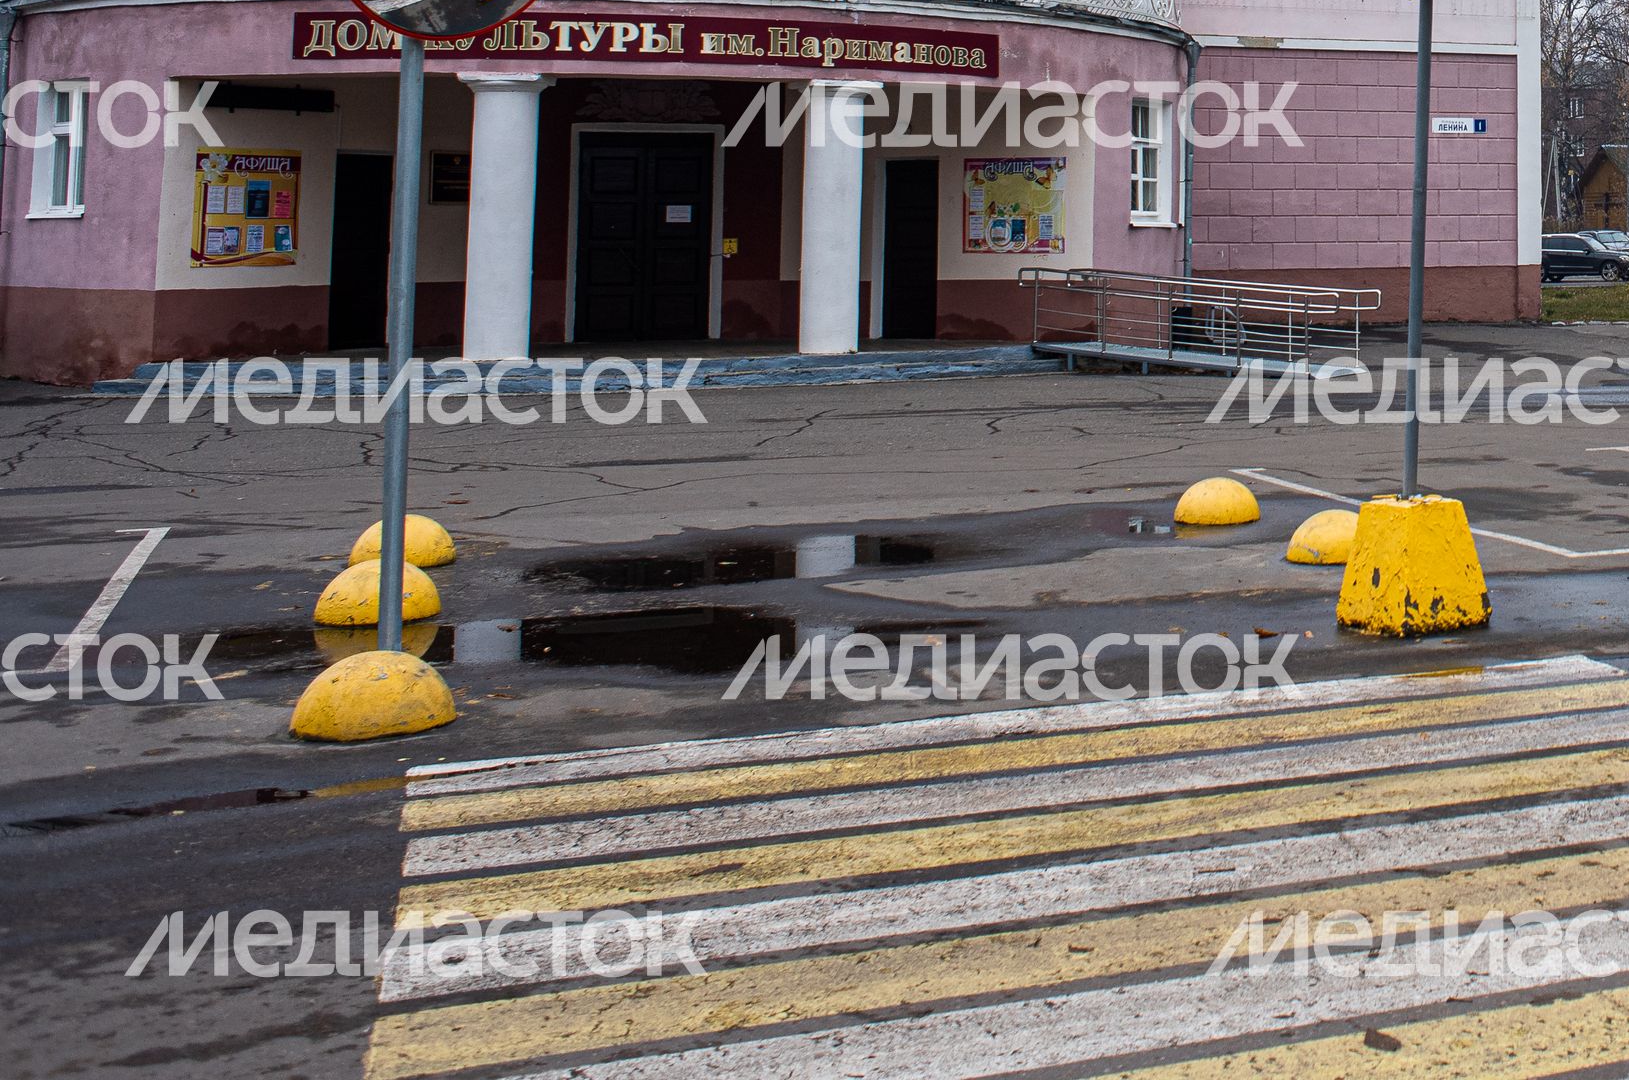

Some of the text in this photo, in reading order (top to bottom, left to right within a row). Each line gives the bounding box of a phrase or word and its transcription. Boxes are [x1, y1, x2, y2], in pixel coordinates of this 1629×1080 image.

[303, 19, 403, 57] ДОМ
[1438, 123, 1468, 131] ЛЕНИНА
[234, 156, 294, 178] АФИША
